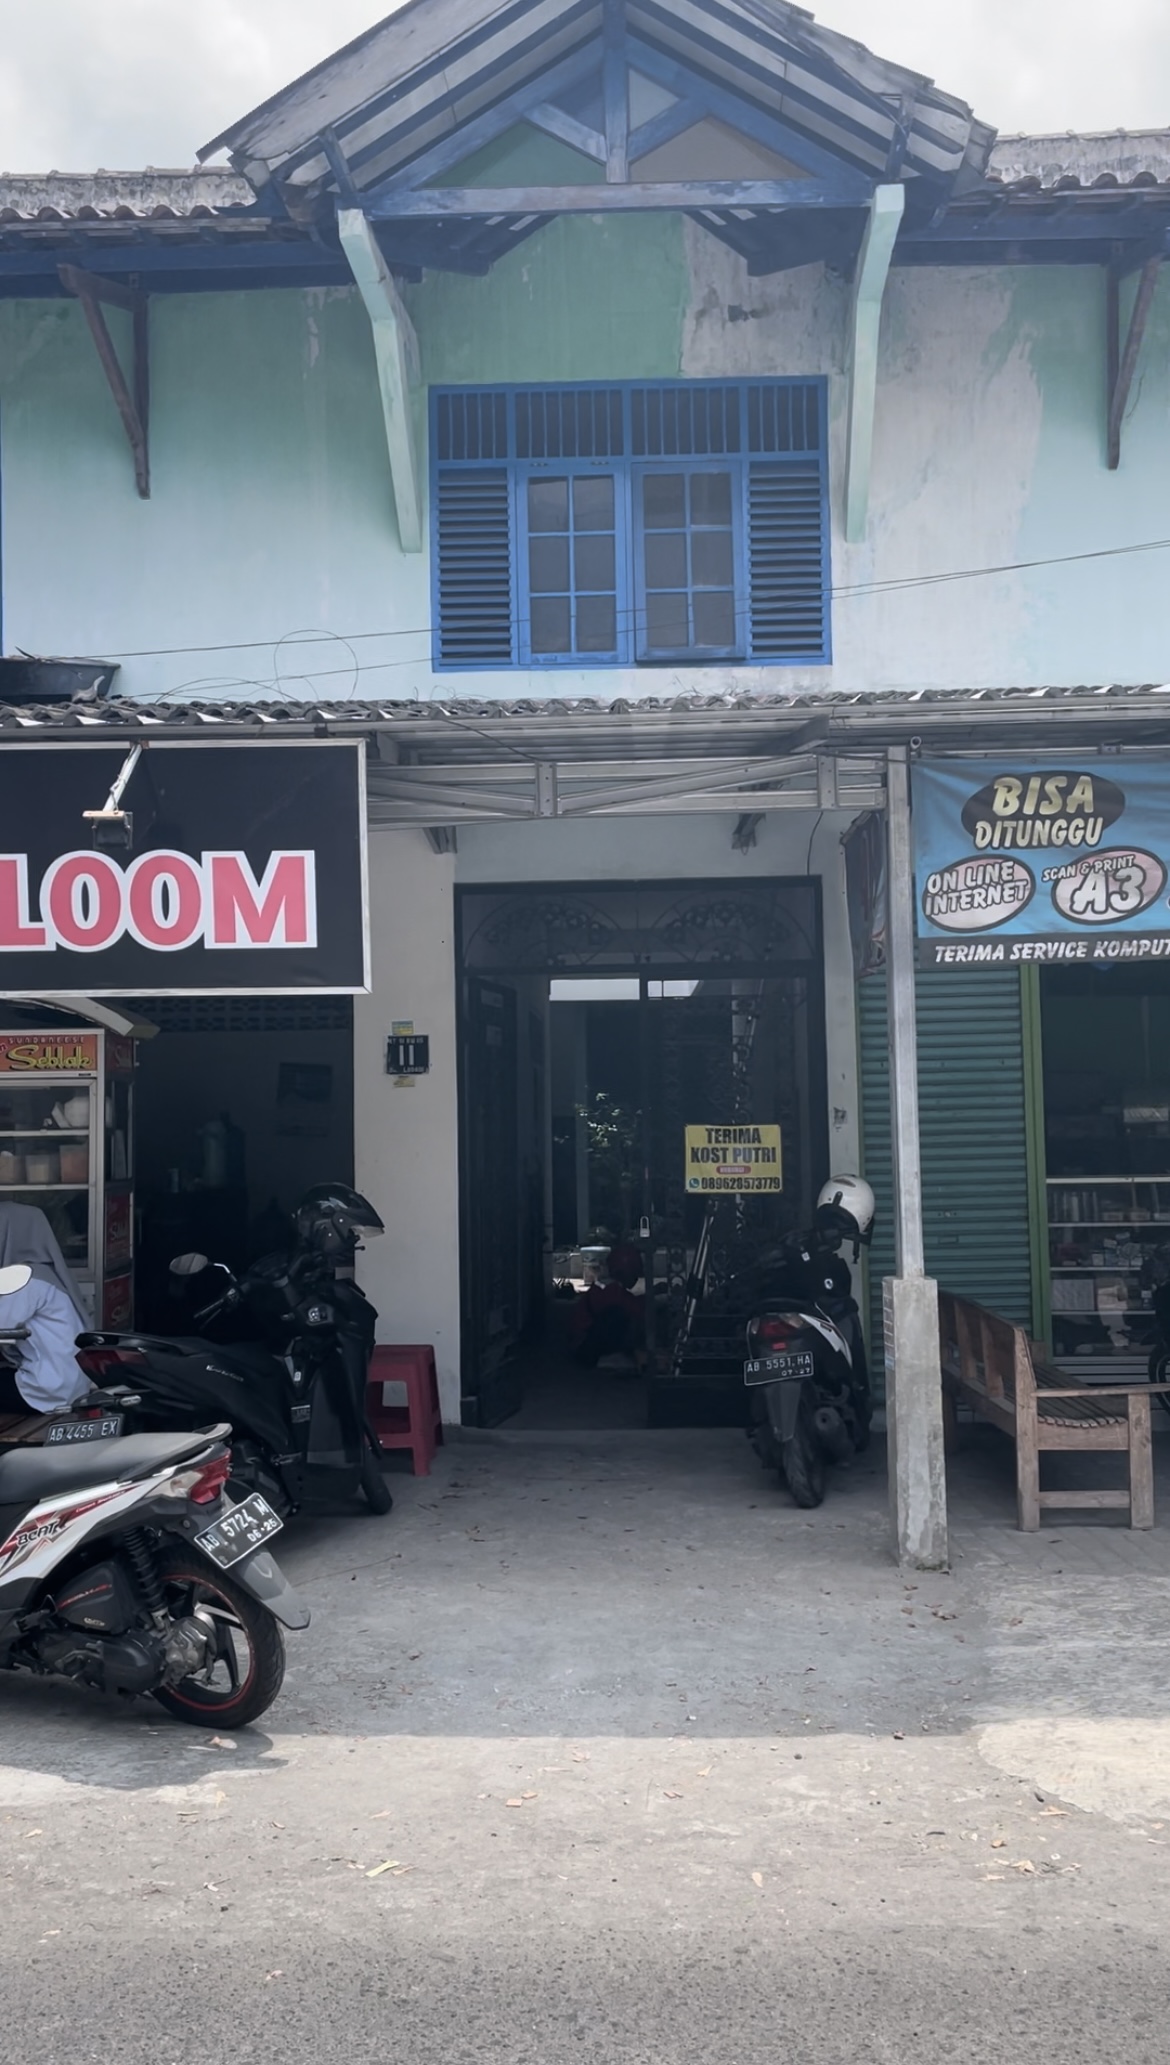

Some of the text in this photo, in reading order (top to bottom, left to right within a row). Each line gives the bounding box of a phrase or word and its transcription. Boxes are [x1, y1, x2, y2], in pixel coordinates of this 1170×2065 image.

[992, 775, 1094, 816] BISA
[974, 817, 1104, 848] DITUNGGU
[1043, 865, 1076, 882] SCAN
[1094, 855, 1135, 873] PRINT
[925, 879, 1029, 916] INTERNET
[1071, 867, 1145, 915] A3
[935, 943, 1004, 962] TERIMA
[1010, 941, 1088, 960] SERVICE
[705, 1127, 762, 1144] TERIMA
[690, 1146, 777, 1163] KOST PUTRI
[765, 1357, 791, 1370] 5551
[797, 1354, 811, 1365] HA
[50, 1420, 118, 1441] AB 4455 EX
[200, 1533, 220, 1552] AB
[220, 1508, 260, 1538] 5724
